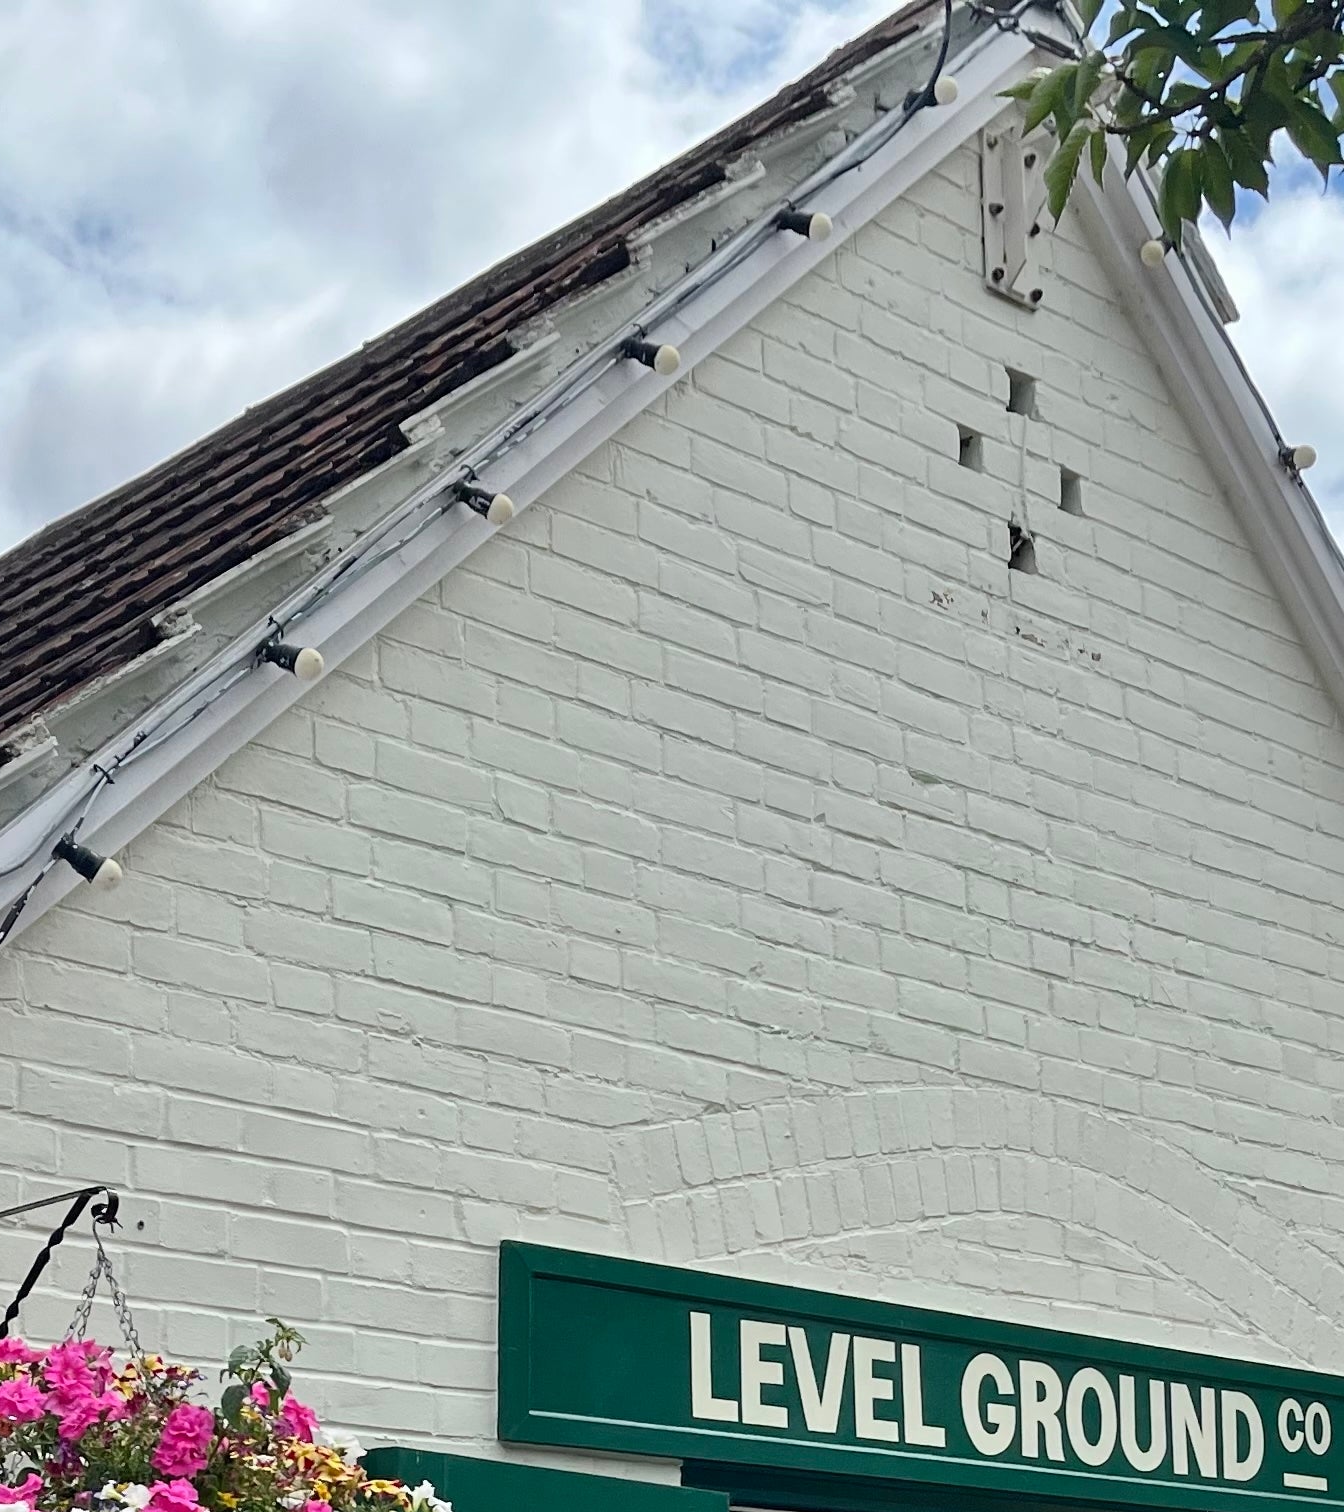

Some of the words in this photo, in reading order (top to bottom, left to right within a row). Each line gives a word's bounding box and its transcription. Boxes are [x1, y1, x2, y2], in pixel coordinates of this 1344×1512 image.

[689, 1310, 947, 1449] LEVEL
[960, 1352, 1265, 1482] GROUND
[1277, 1397, 1332, 1458] CO
